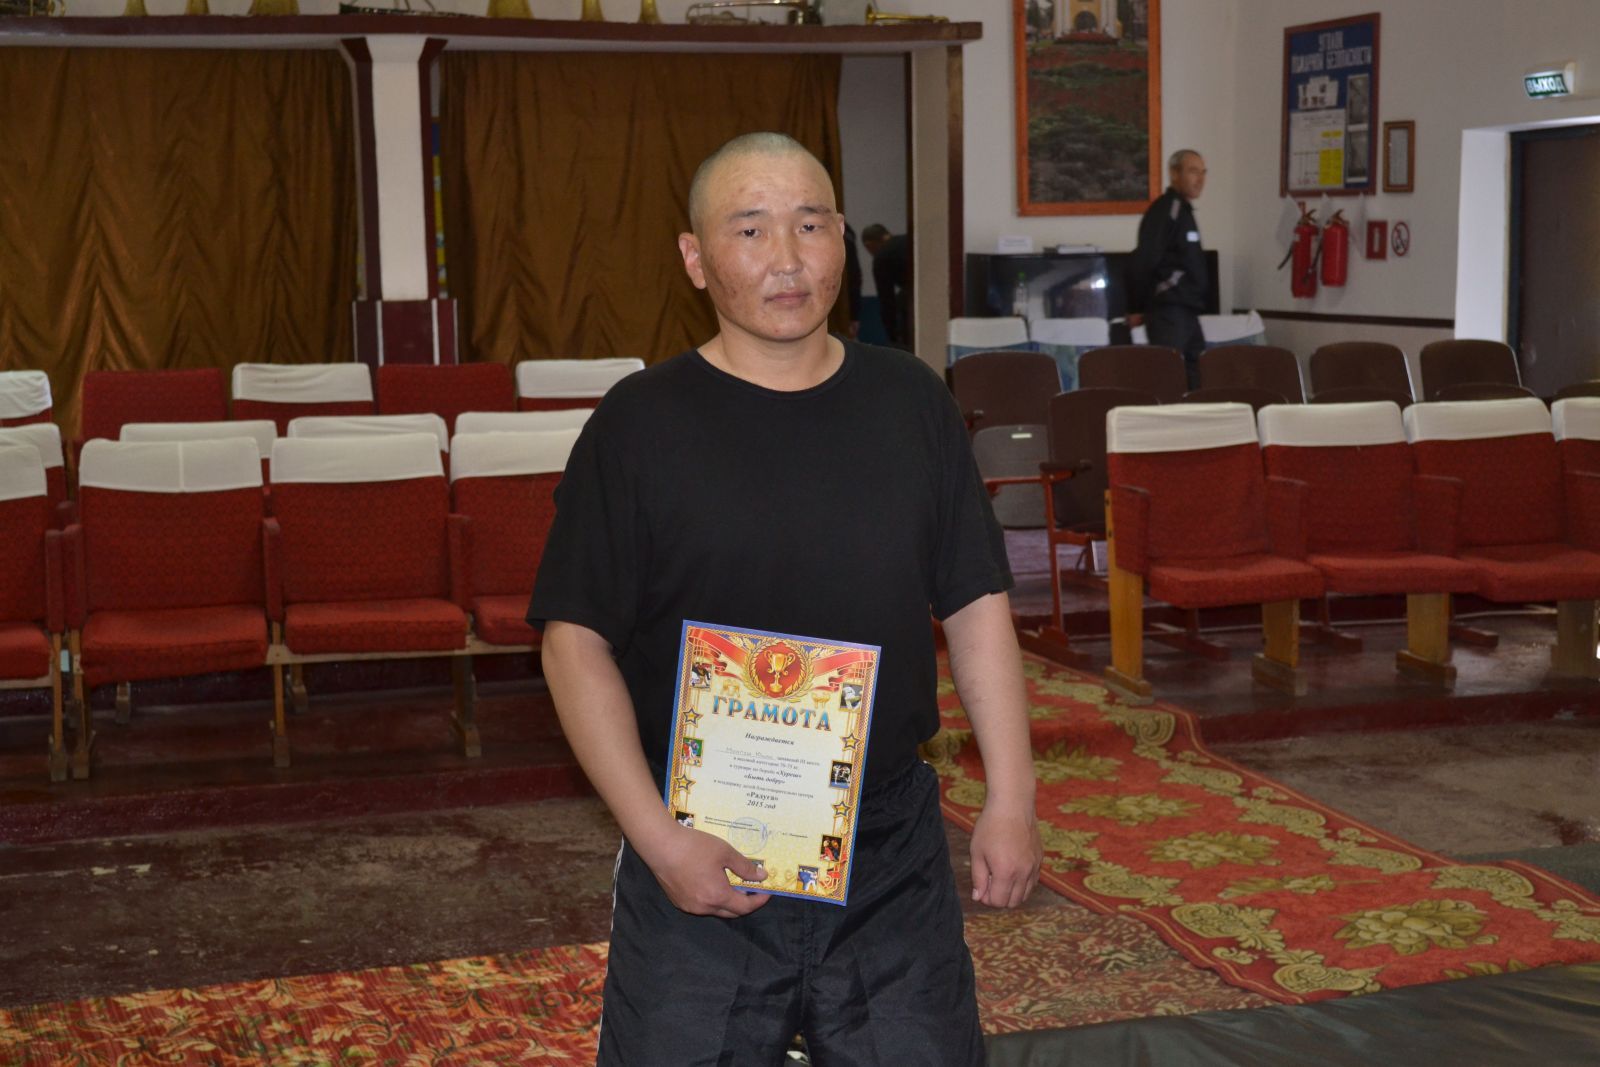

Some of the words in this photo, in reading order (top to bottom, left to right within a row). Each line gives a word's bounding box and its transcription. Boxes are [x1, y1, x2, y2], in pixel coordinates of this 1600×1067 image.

[1526, 76, 1566, 94] ВЫХОД
[711, 694, 832, 732] ГРАМОТА
[745, 732, 795, 747] Награждается
[746, 791, 779, 803] «Радуга»
[747, 800, 763, 808] 2015
